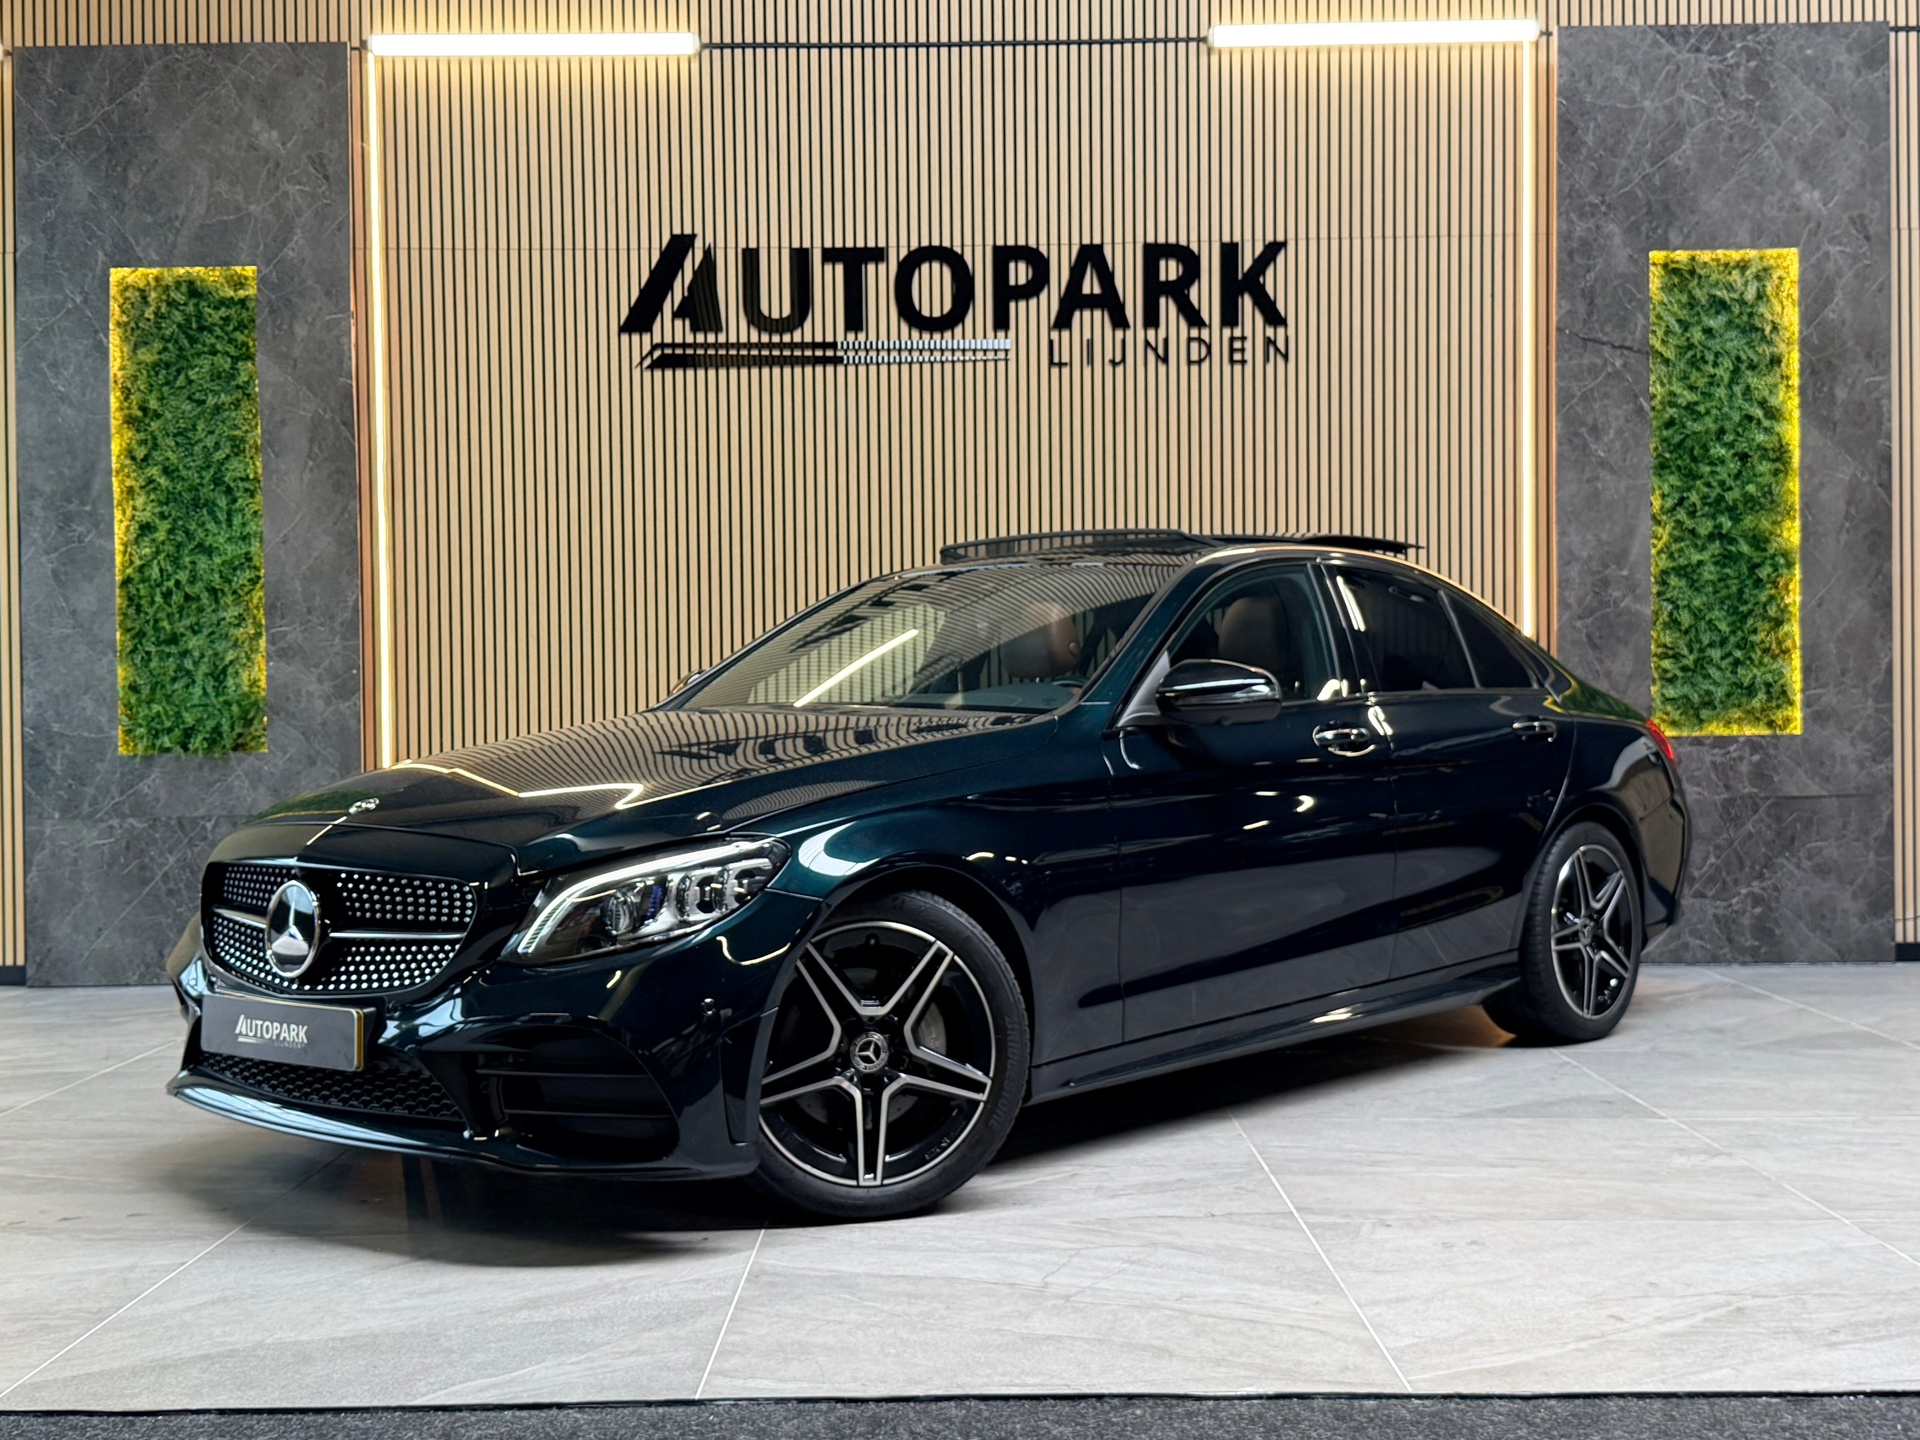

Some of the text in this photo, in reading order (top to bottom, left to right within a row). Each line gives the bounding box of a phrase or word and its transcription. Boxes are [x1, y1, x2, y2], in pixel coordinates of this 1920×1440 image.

[619, 233, 1288, 333] AUTOPARK
[1050, 335, 1289, 367] LIJNDEN
[234, 1014, 308, 1044] AUTOPARK
